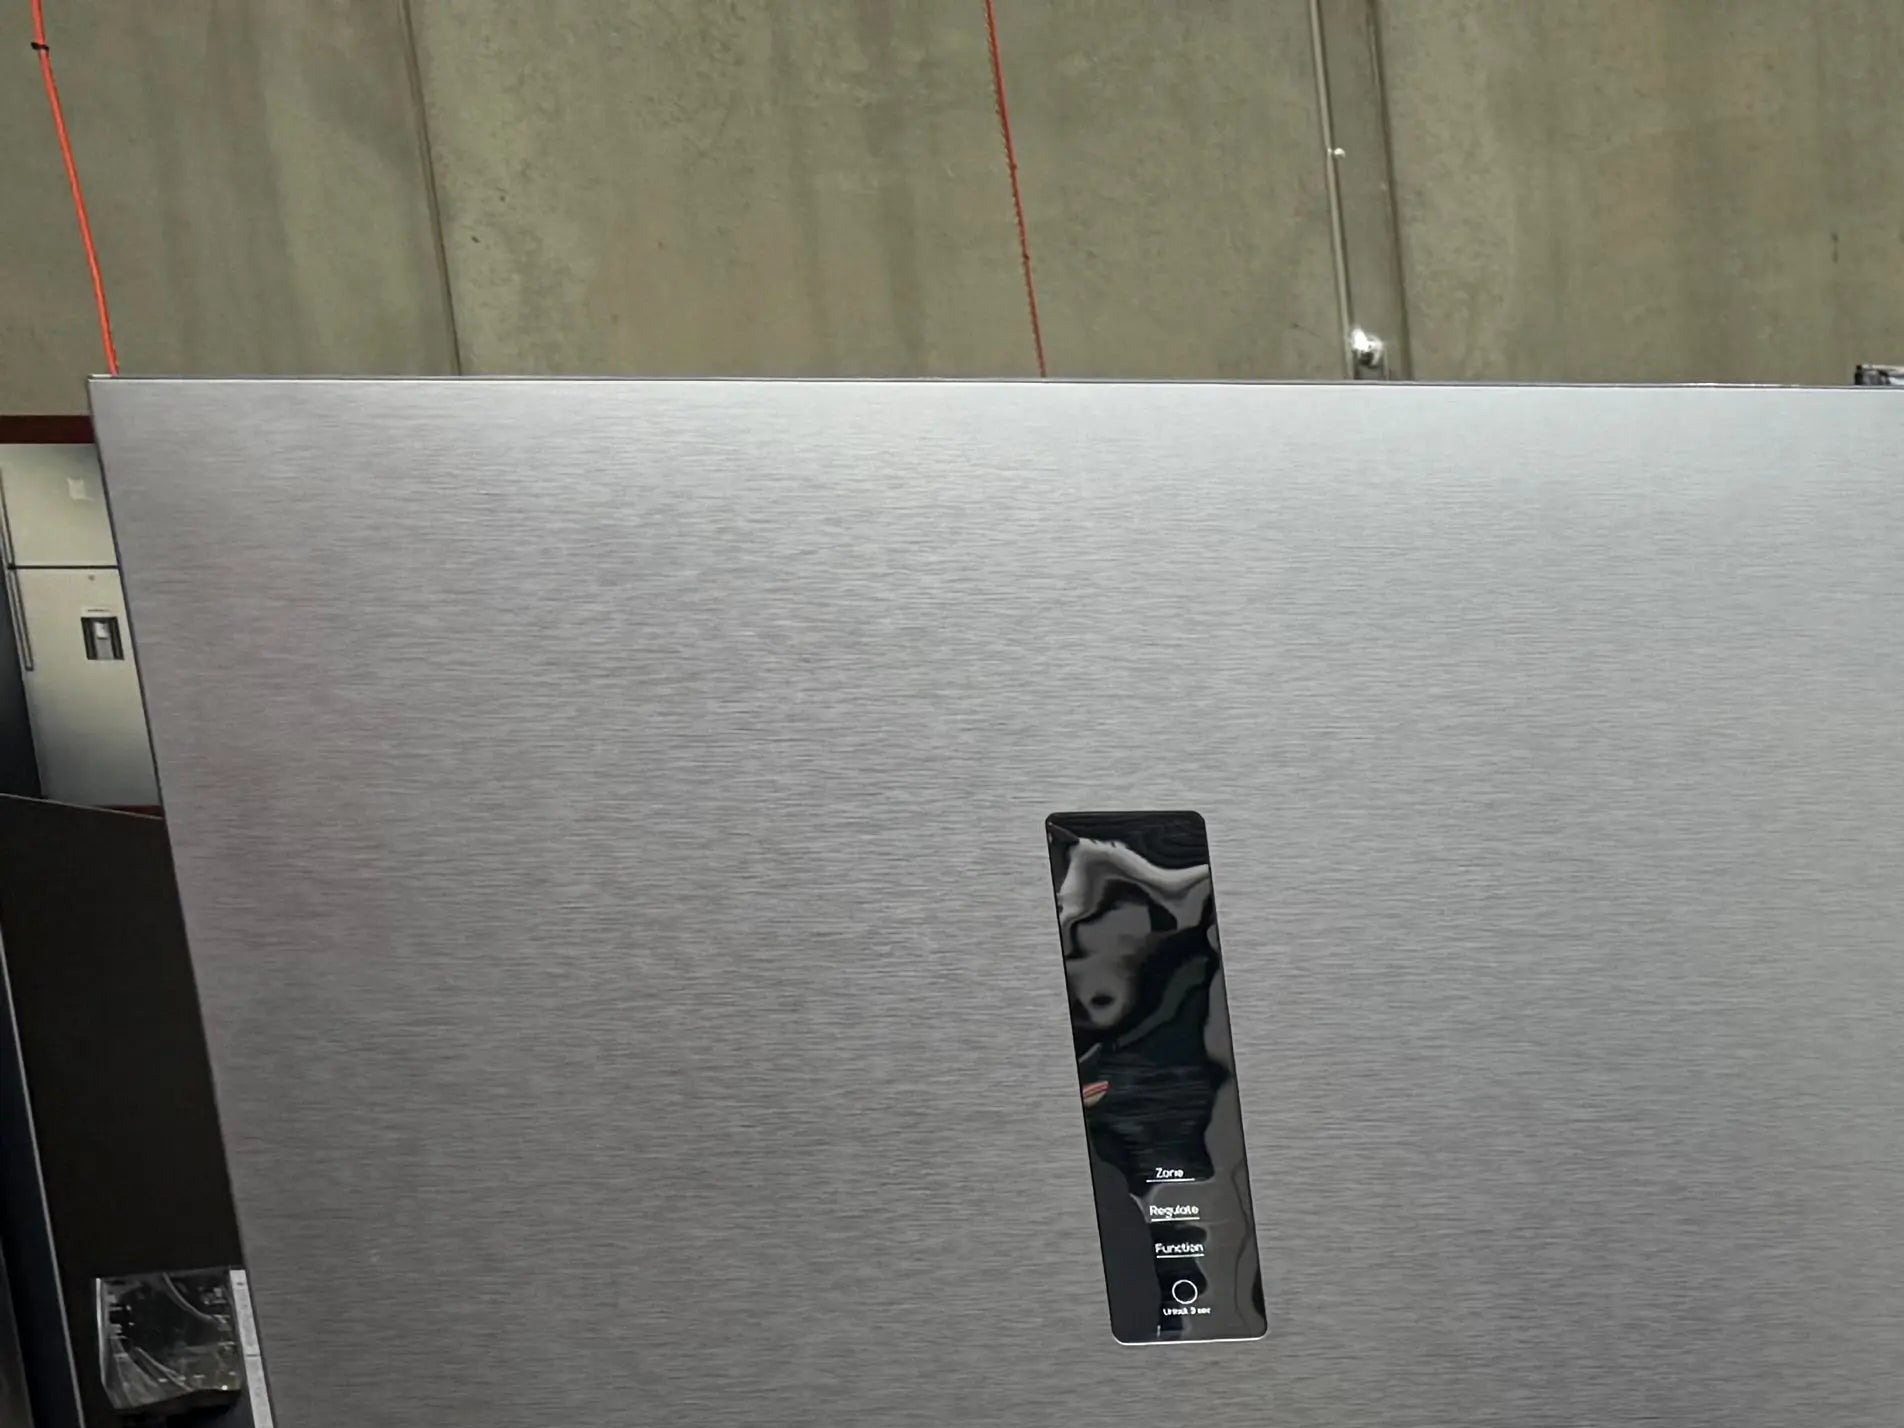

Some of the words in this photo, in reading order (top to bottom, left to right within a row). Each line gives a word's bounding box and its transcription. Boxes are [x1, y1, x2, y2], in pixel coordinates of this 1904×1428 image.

[1155, 1167, 1184, 1179] Zone
[1149, 1204, 1199, 1219] Regulate
[1154, 1242, 1204, 1254] Function
